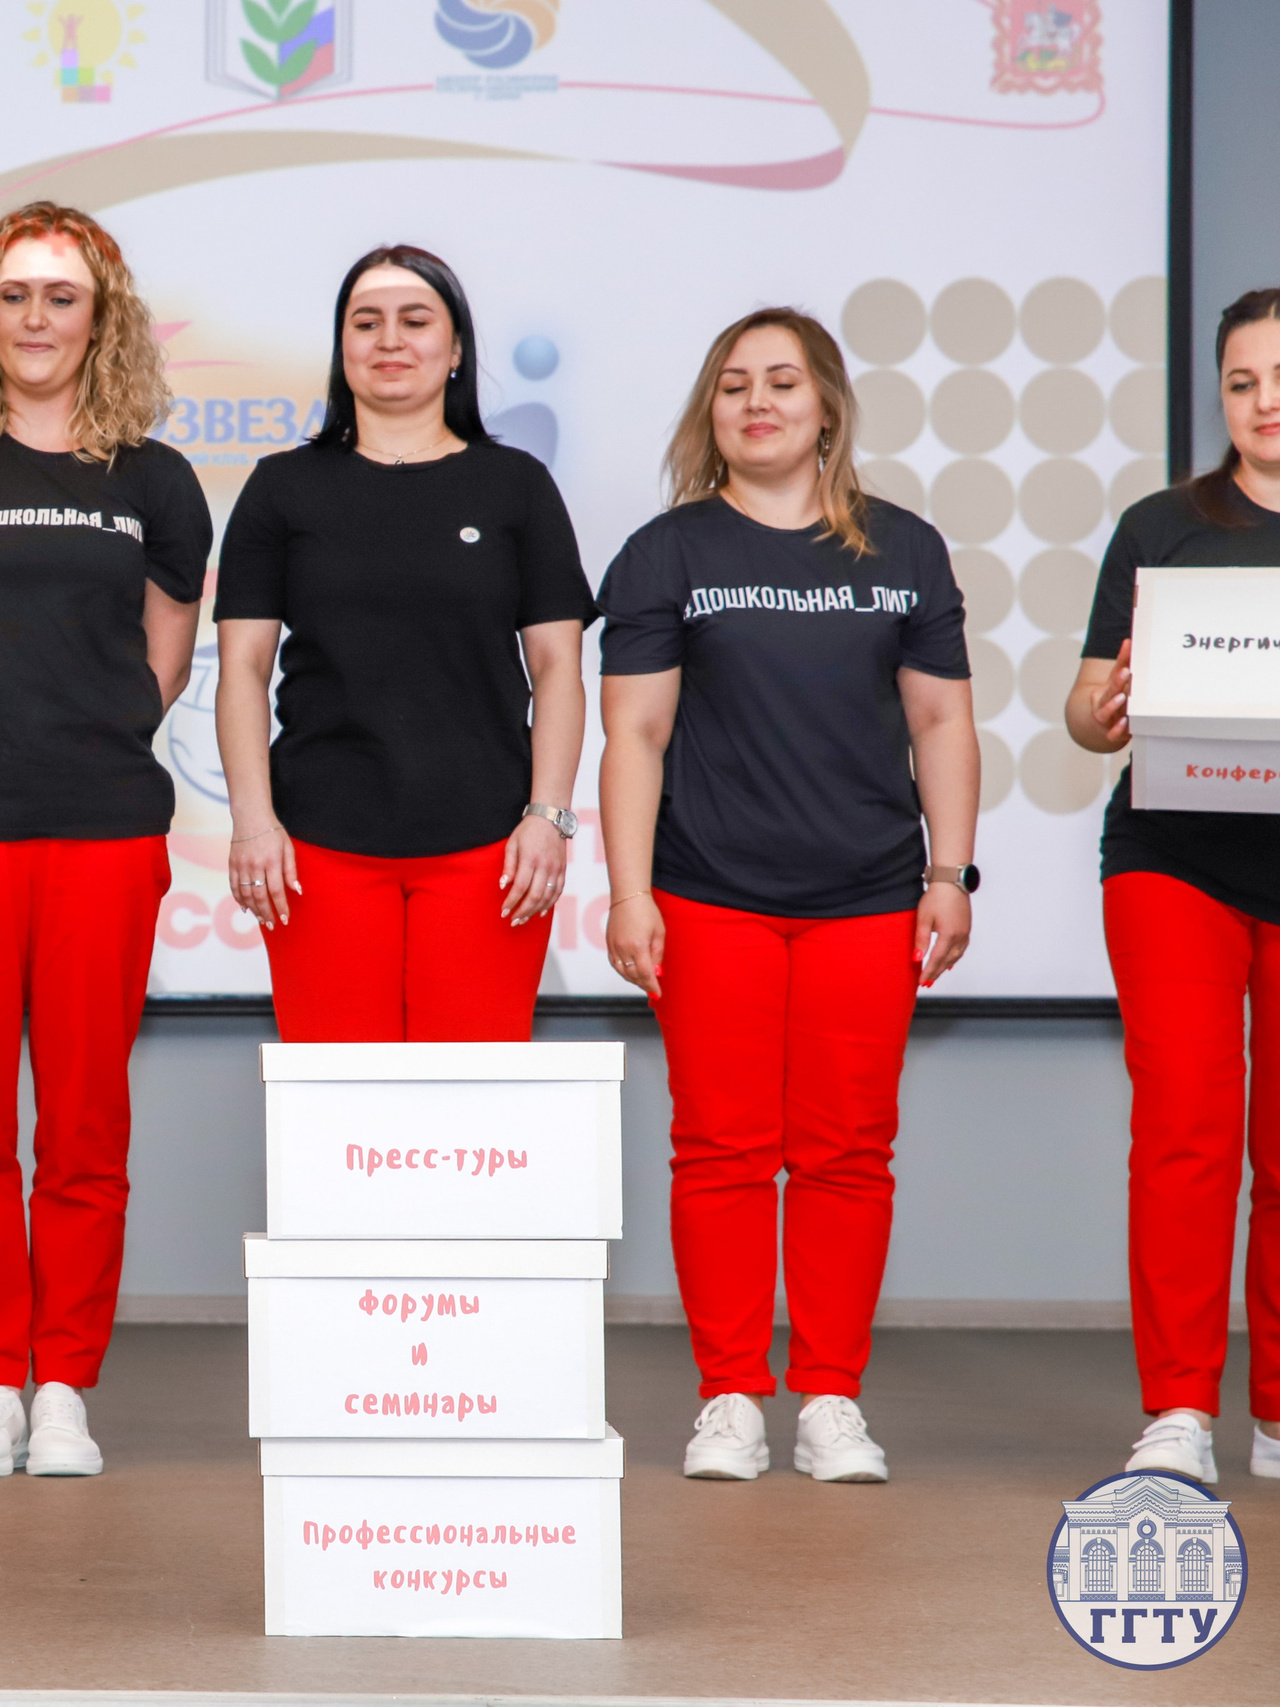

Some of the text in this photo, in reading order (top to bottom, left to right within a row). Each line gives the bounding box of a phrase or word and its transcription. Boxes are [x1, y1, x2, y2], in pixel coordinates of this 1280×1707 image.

[345, 1143, 527, 1177] Пресс-туры
[344, 1392, 497, 1422] семинары
[303, 1519, 577, 1551] Профессиональные
[373, 1569, 508, 1595] конкурсы
